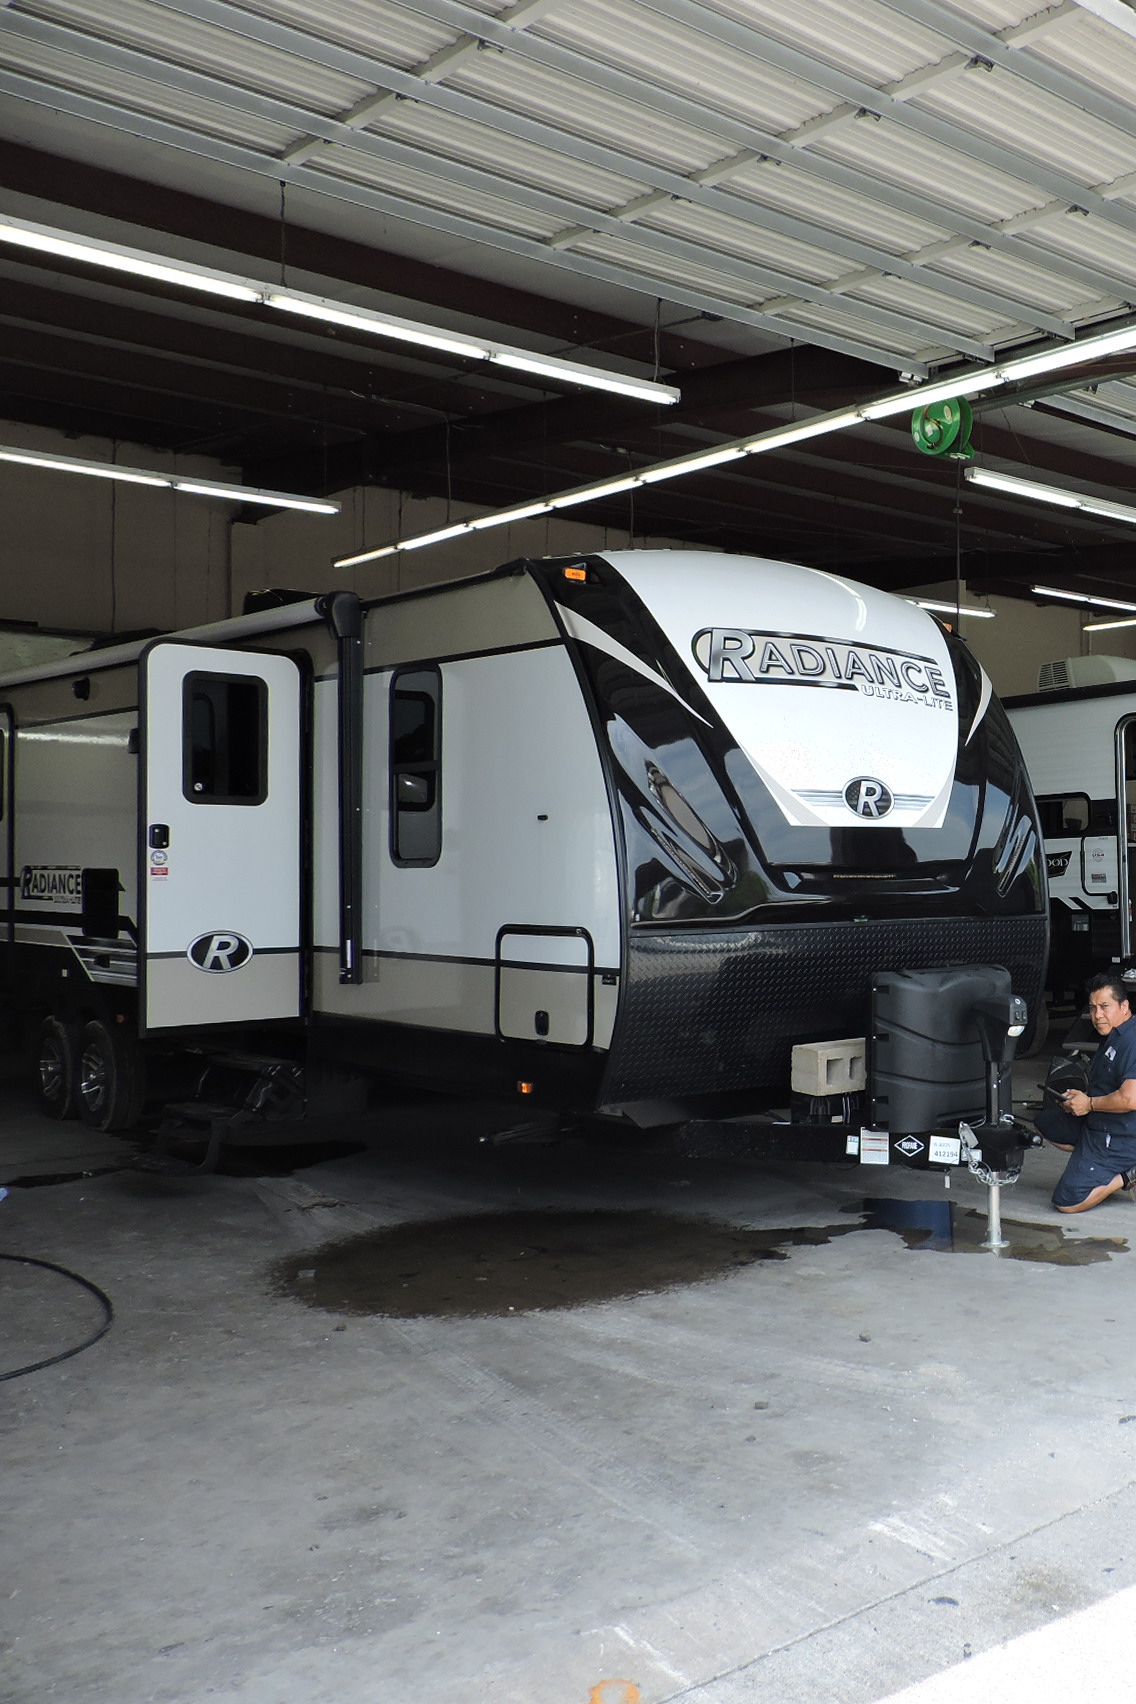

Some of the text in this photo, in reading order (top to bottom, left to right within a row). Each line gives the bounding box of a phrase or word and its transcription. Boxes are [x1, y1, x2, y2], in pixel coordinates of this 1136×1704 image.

[706, 628, 951, 698] RADIANCE
[861, 684, 954, 711] ULTRA-LITE
[855, 780, 882, 817] R
[21, 866, 82, 898] RADIANCE
[202, 935, 239, 970] R
